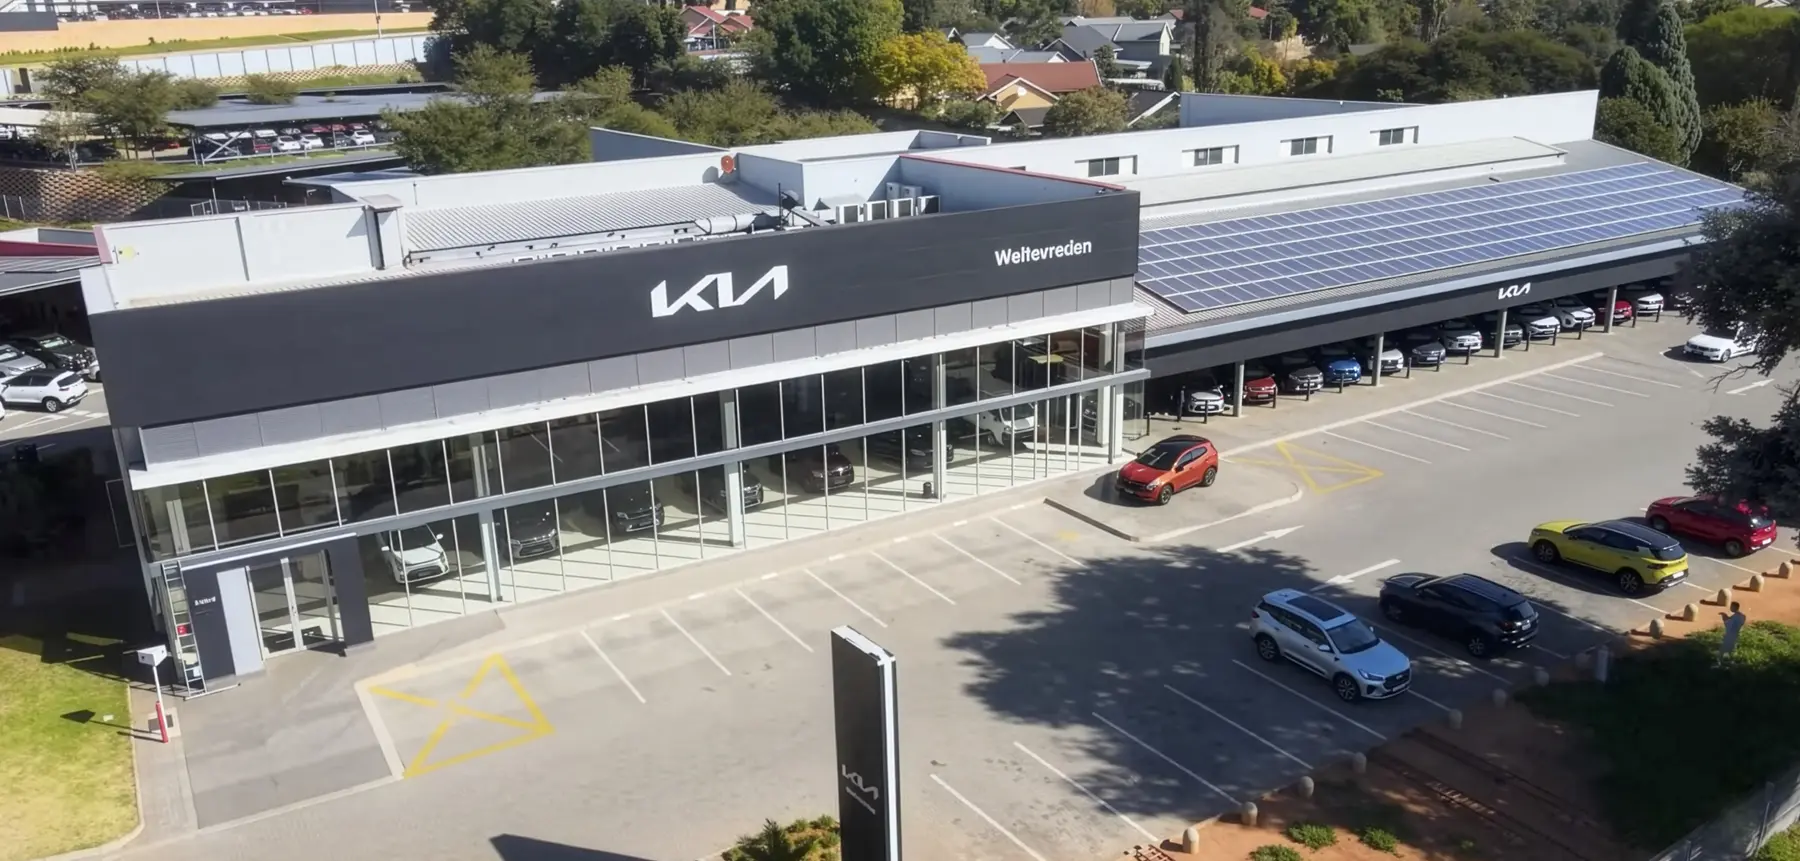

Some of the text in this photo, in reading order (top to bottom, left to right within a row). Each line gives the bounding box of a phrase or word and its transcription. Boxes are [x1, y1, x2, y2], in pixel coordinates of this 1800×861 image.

[994, 239, 1092, 267] Weltevreden
[650, 264, 788, 318] KIA
[1498, 282, 1531, 300] KIA
